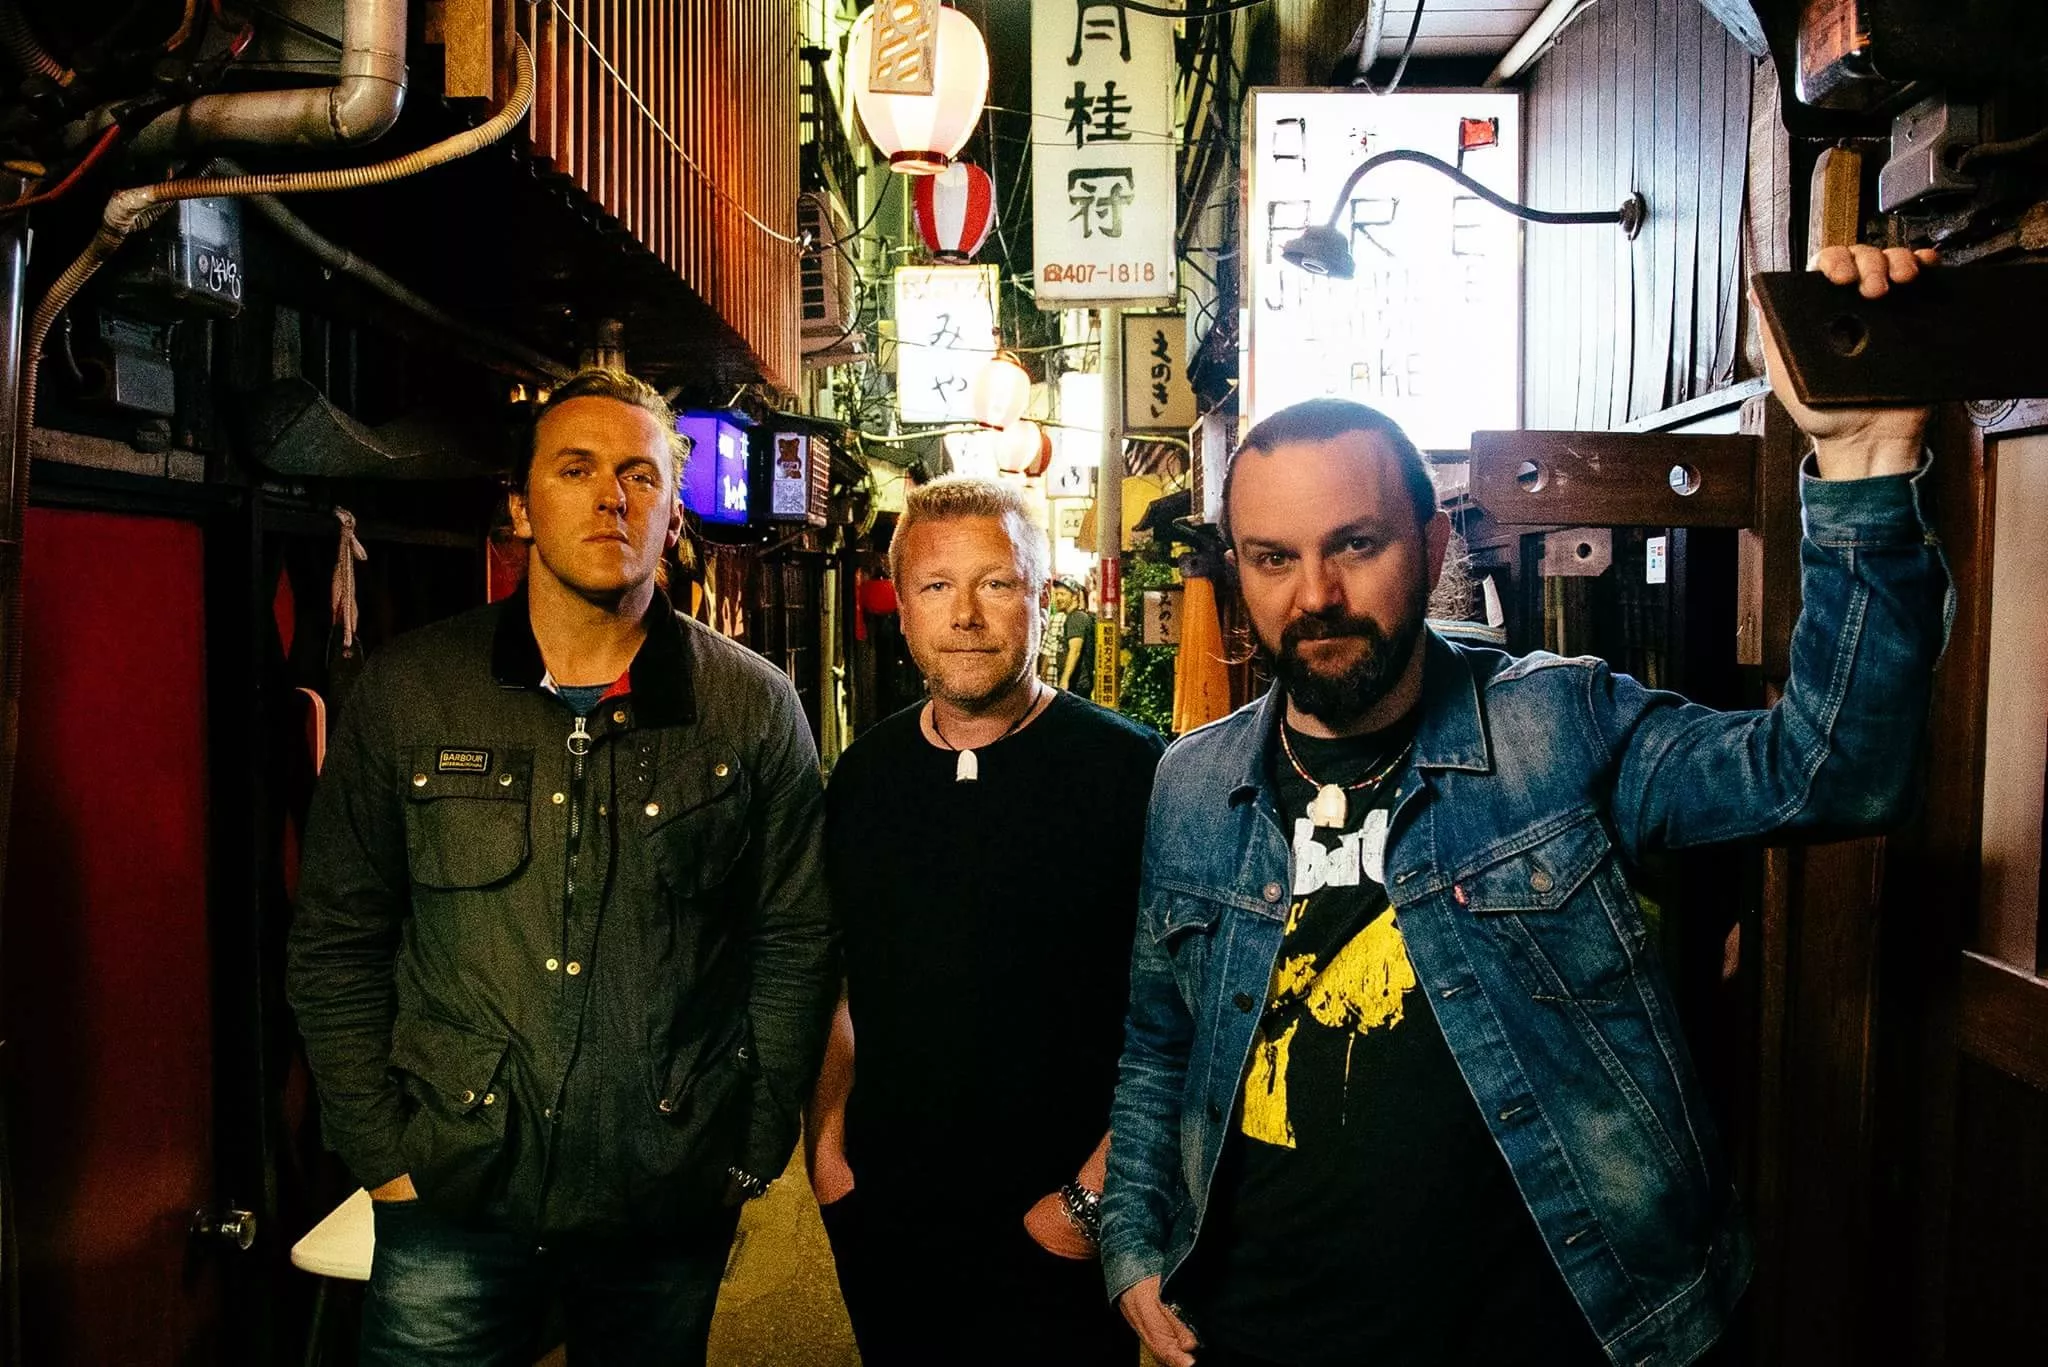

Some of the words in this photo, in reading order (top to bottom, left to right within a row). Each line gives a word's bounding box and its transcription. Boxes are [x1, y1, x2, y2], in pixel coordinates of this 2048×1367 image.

[1065, 0, 1136, 239] 月桂冠
[1062, 262, 1156, 283] 407-1818
[930, 312, 969, 404] みや
[443, 753, 483, 762] BARBOUR
